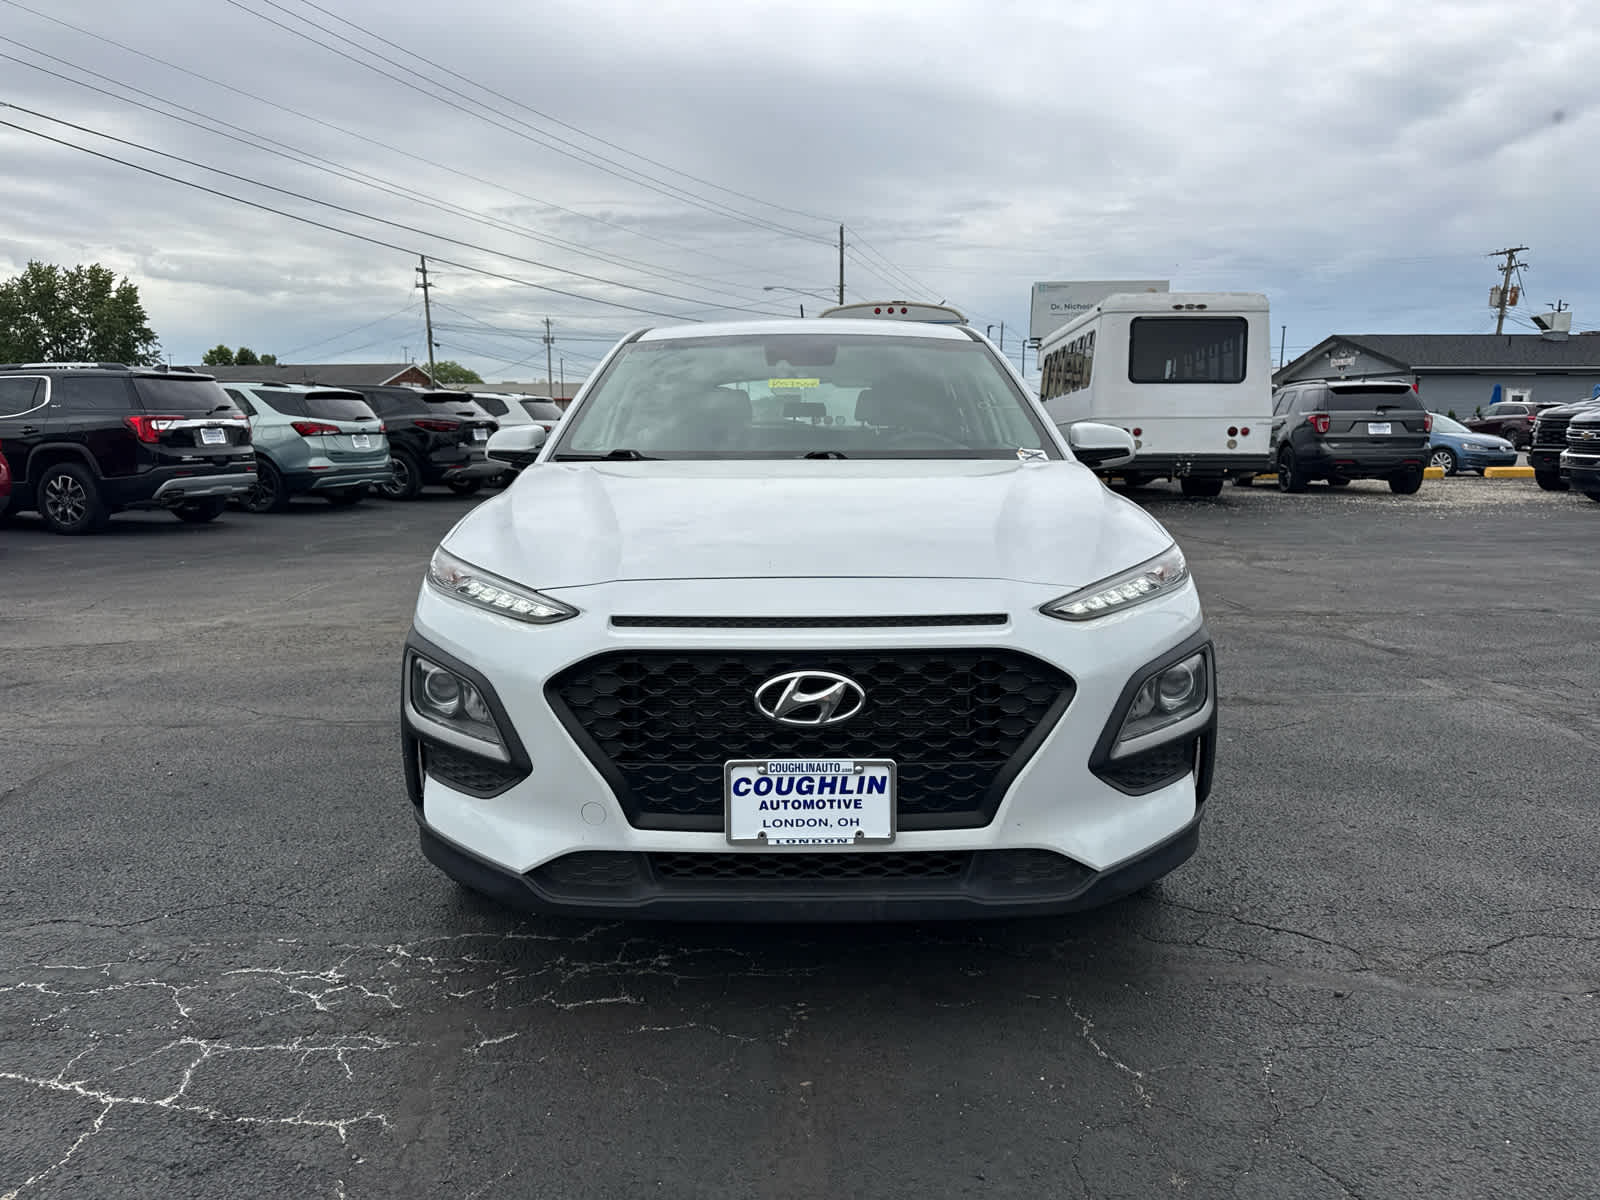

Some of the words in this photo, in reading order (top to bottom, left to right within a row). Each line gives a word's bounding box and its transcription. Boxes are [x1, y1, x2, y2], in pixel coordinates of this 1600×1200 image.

[732, 776, 887, 796] COUGHLIN
[759, 799, 863, 810] AUTOMOTIVE
[763, 818, 833, 828] LONDON,
[837, 818, 860, 827] OH
